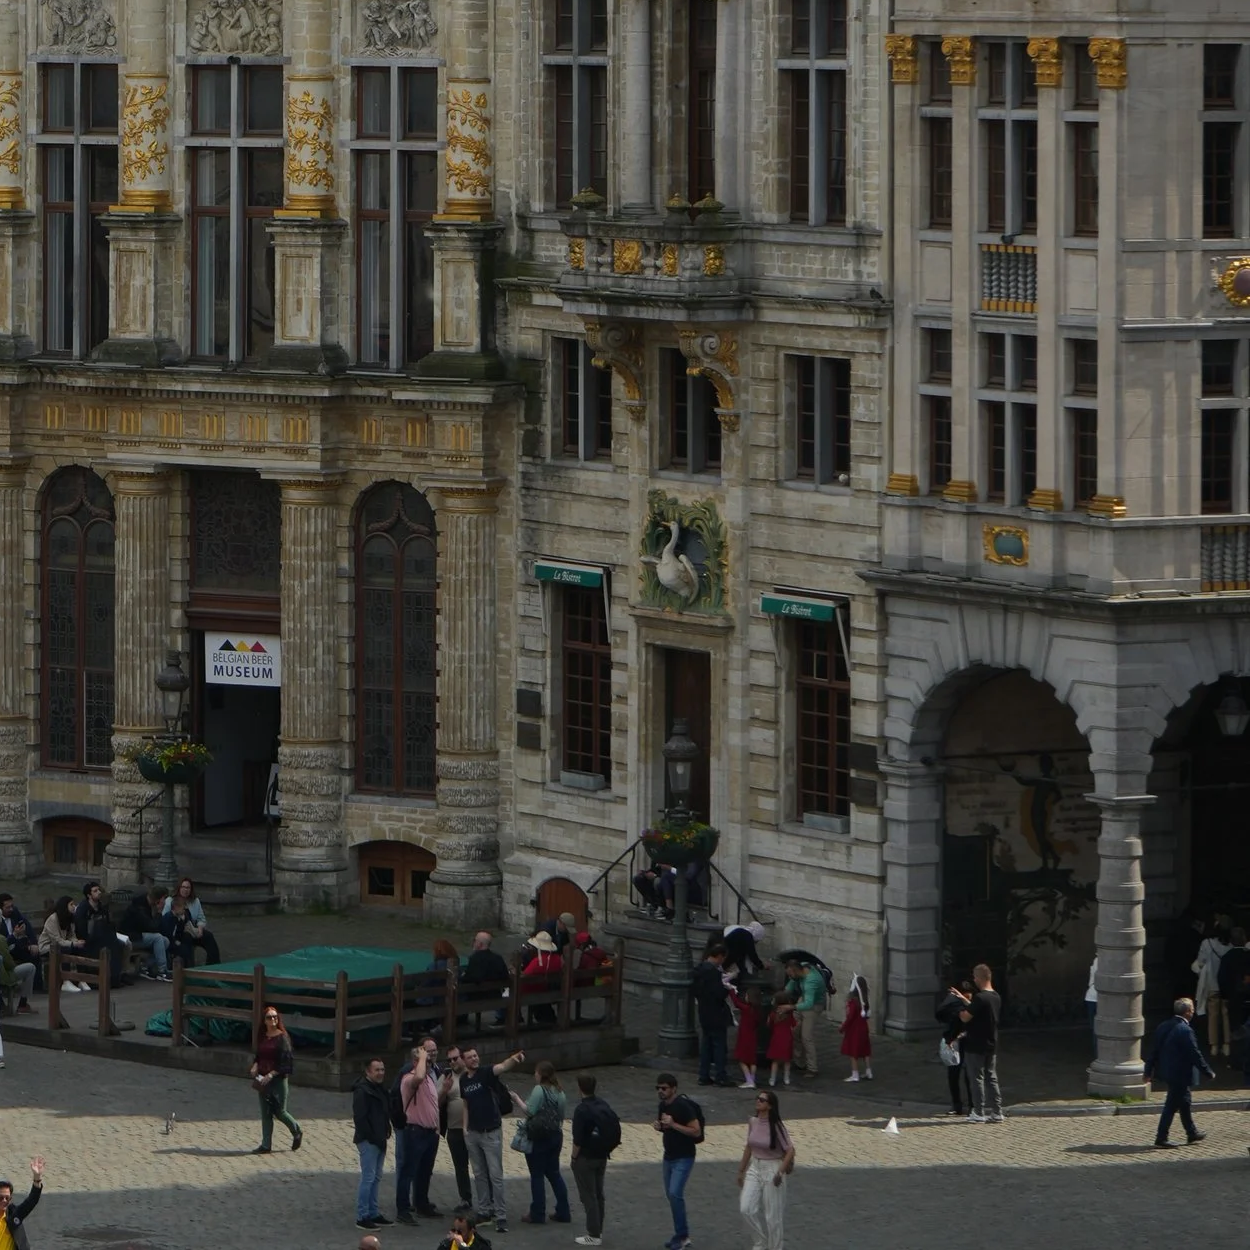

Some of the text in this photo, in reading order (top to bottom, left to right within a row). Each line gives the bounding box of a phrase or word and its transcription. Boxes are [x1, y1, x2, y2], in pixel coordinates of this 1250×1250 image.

[553, 570, 561, 580] Le
[781, 603, 790, 614] Le
[212, 652, 273, 665] BELGIAN BEER
[213, 665, 273, 679] MUSEUM
